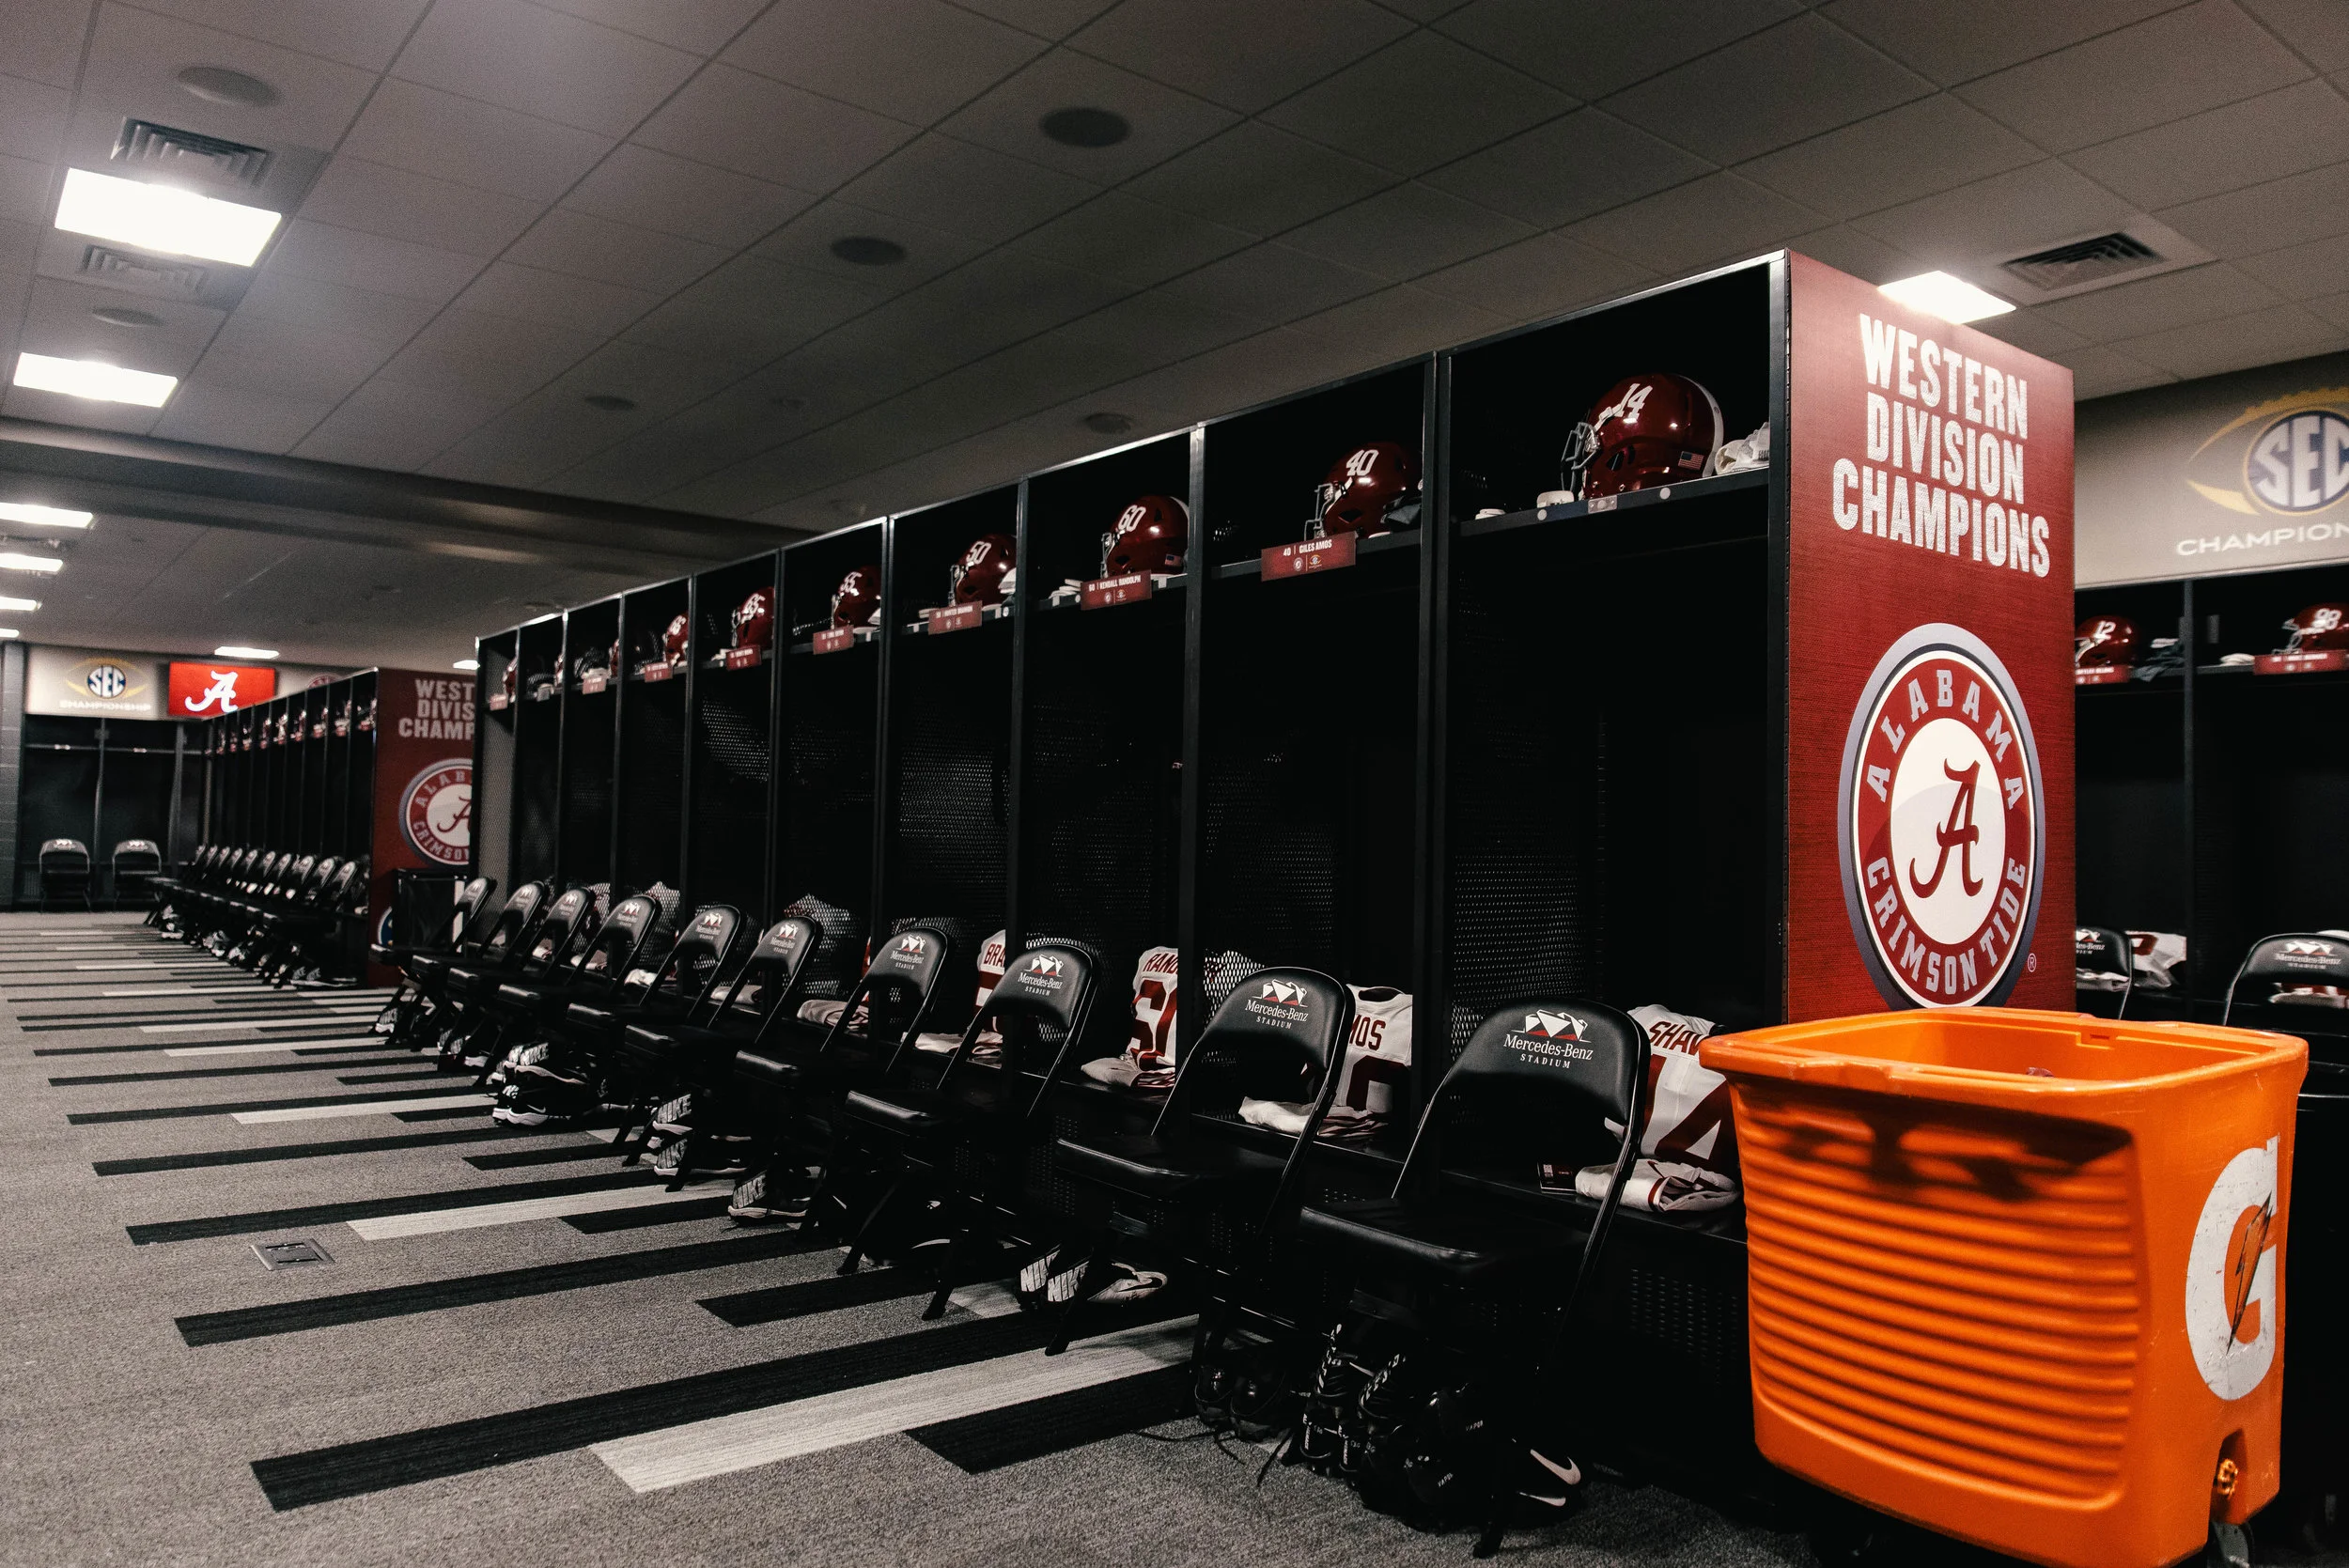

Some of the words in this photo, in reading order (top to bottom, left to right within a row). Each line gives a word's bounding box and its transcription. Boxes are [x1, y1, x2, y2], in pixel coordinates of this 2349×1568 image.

[1859, 313, 2028, 440] WESTERN
[1618, 383, 1654, 419] 14
[1346, 449, 1379, 476] 40
[1867, 392, 2025, 505] DIVISION
[1118, 505, 1146, 532] 60
[1832, 458, 2050, 578] CHAMPIONS
[966, 541, 992, 565] 50
[2093, 621, 2116, 640] 12
[88, 665, 125, 697] SEC
[1867, 669, 2025, 810] ALABAMA
[1867, 856, 1979, 996] CRIMSON
[1980, 858, 2027, 968] TIDE
[1018, 971, 1064, 990] Mercedes-Benz
[1025, 986, 1051, 996] STADIUM
[1245, 1000, 1309, 1022] Mercedes-Benz
[1256, 1016, 1293, 1030] STADIUM
[1503, 1033, 1594, 1061] Mercedes-Benz
[1520, 1053, 1571, 1069] STADIUM
[658, 1094, 692, 1124] NIKE
[2186, 1132, 2281, 1401] G
